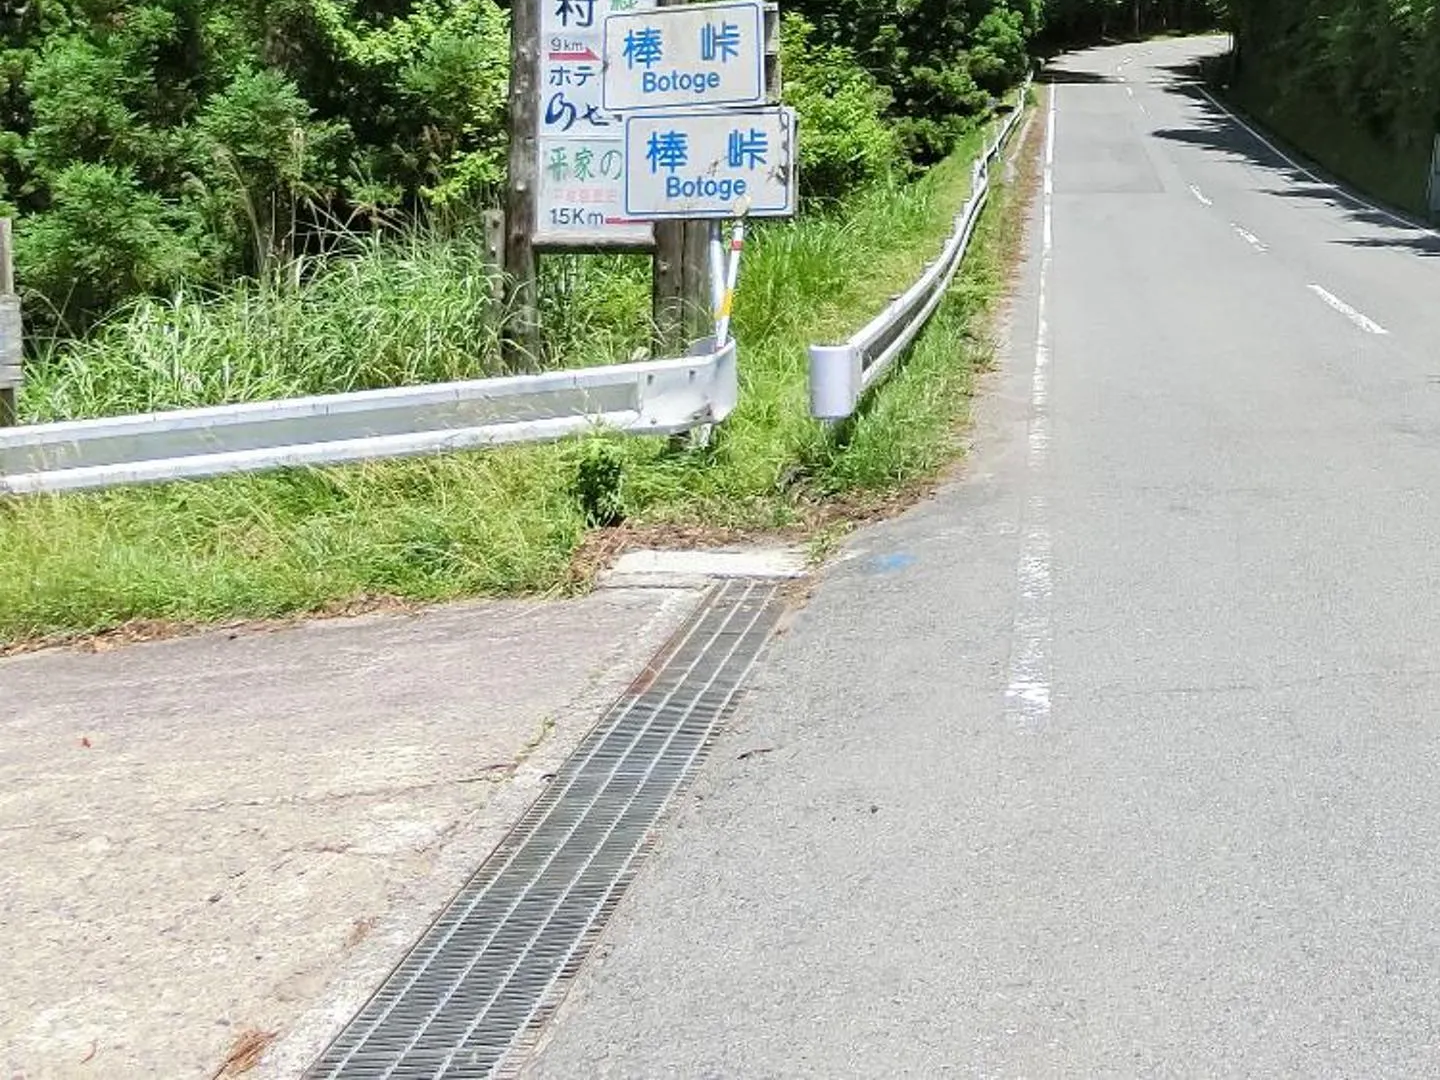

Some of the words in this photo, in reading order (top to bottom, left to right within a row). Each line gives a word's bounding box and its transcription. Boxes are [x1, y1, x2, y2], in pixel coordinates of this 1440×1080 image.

[551, 37, 584, 52] 9km
[642, 69, 721, 94] Botoge
[545, 92, 623, 132] のせ
[665, 175, 747, 201] Botoge
